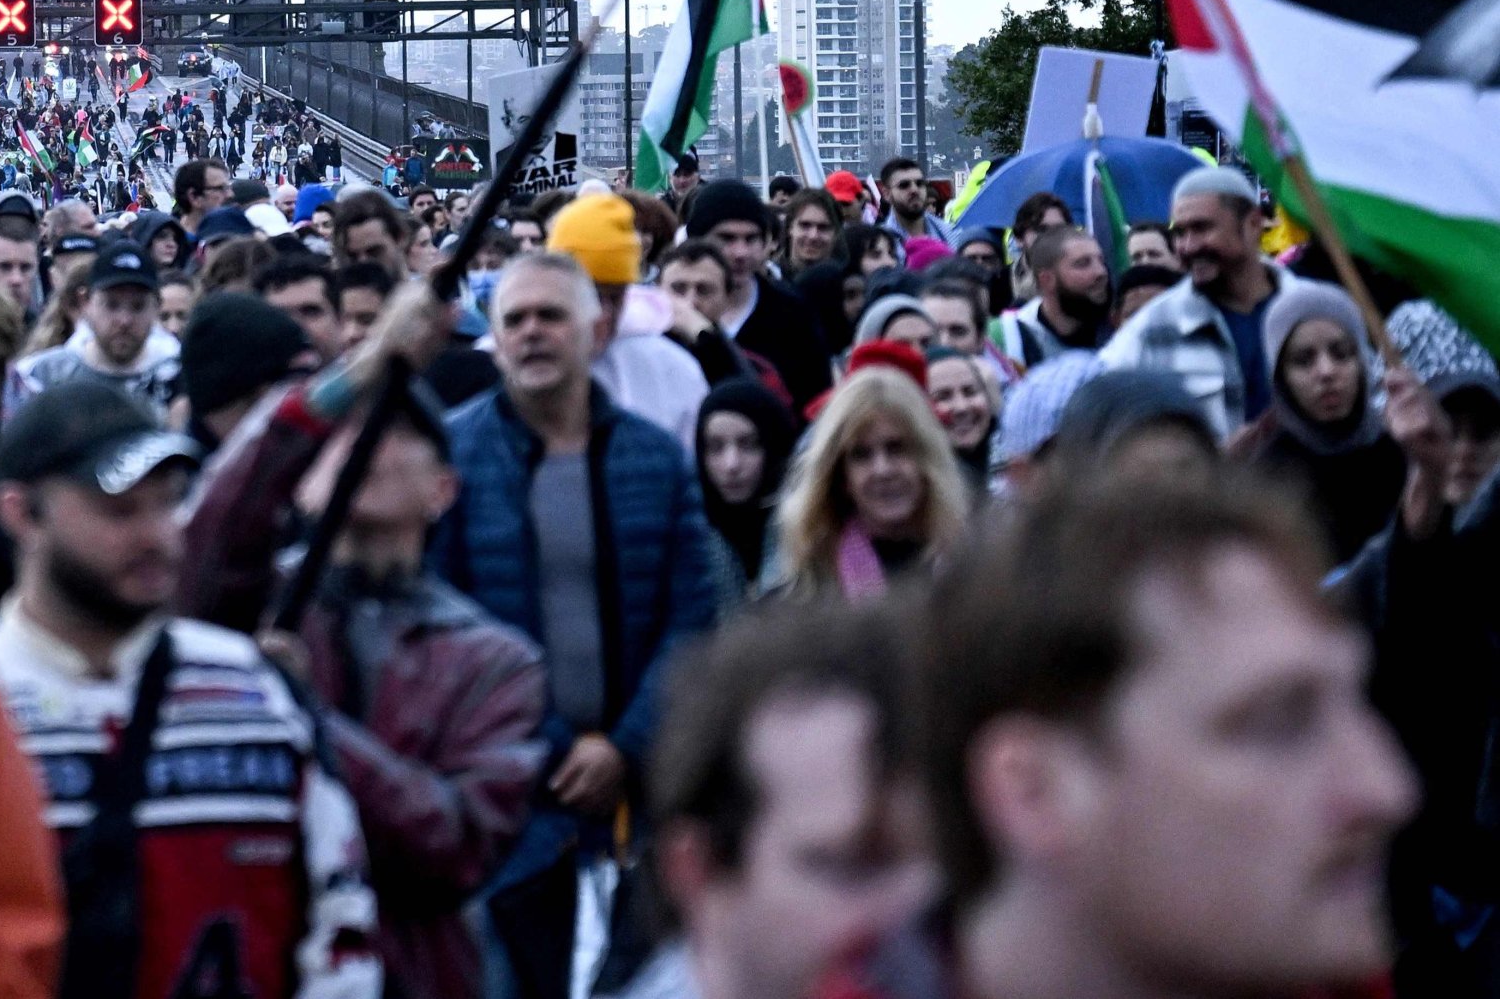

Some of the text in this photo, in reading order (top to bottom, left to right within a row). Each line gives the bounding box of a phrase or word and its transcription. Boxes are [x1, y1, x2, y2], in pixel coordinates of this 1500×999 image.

[6, 33, 17, 46] 5
[113, 32, 124, 44] 6
[509, 173, 577, 194] RIMINAL
